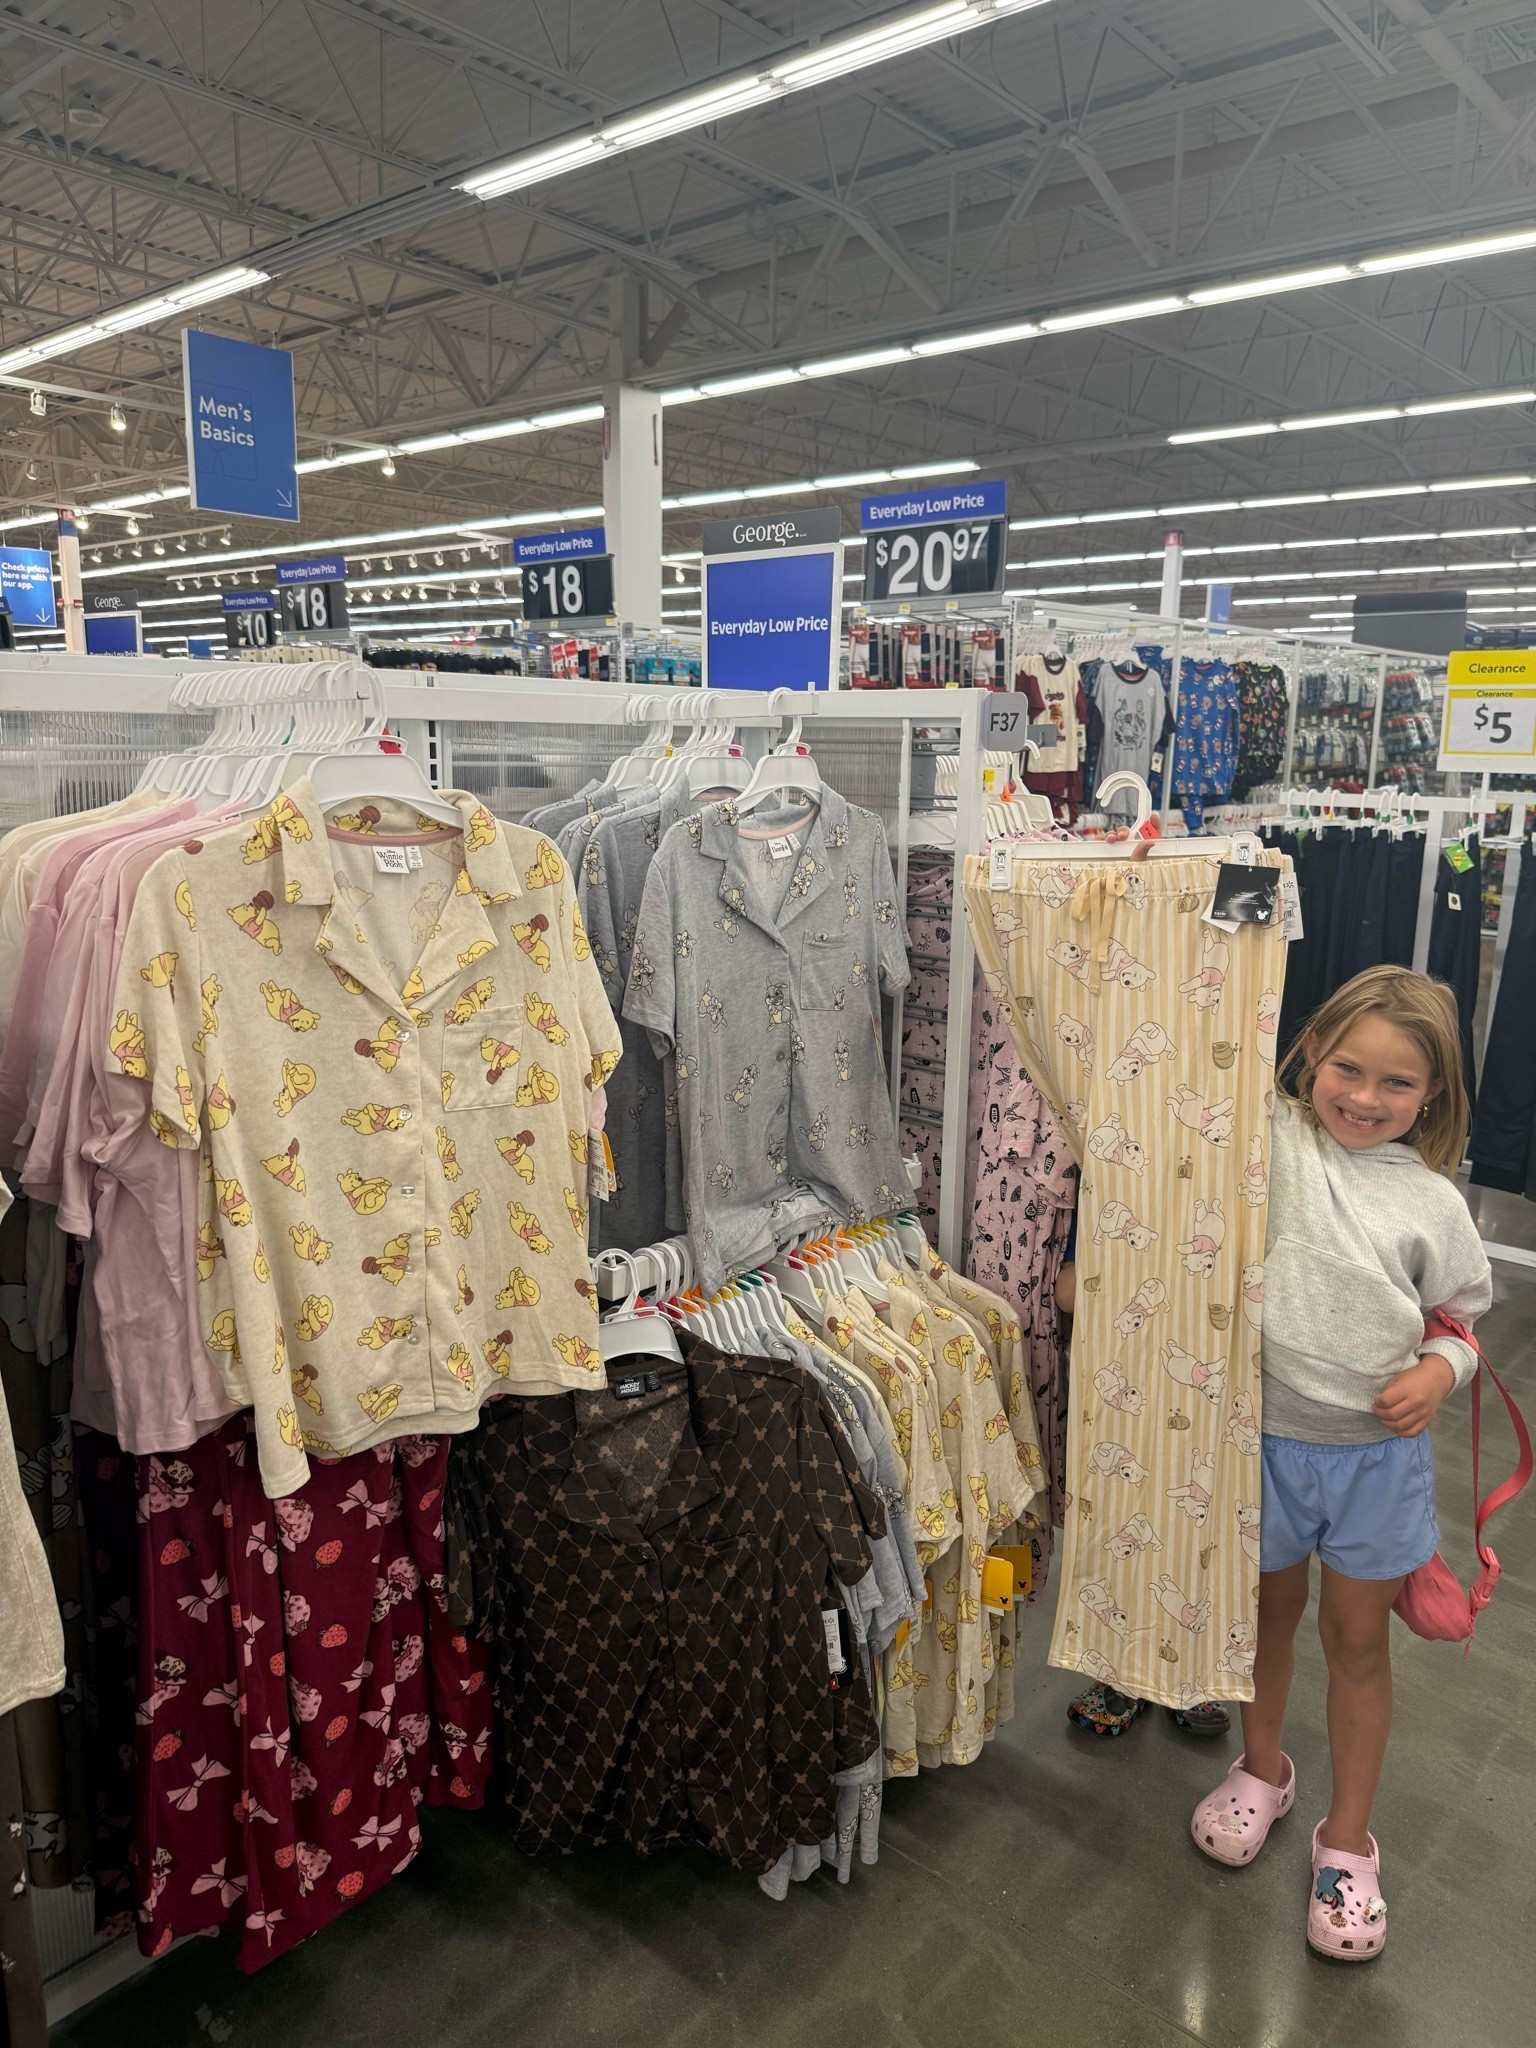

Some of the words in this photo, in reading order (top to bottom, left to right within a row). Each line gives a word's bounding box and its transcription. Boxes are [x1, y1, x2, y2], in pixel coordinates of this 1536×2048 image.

[199, 395, 252, 422] Men's
[200, 420, 255, 447] Basics
[870, 502, 925, 520] Everyday
[926, 499, 951, 514] Low
[953, 494, 985, 510] Price
[519, 543, 555, 556] Everyday
[555, 540, 572, 552] Low
[572, 537, 593, 549] Price
[1, 562, 26, 571] Check
[26, 565, 49, 574] prices
[281, 568, 309, 579] Everyday
[309, 566, 320, 576] Low
[320, 564, 337, 575] Price
[2, 571, 19, 580] here
[30, 573, 48, 582] with
[18, 582, 34, 590] app.
[225, 598, 246, 607] Everyday
[246, 597, 255, 605] Low
[255, 596, 268, 605] Price
[711, 619, 767, 637] Everyday
[769, 618, 794, 633] Low
[796, 616, 829, 632] Price
[1468, 663, 1527, 674] Clearance
[1476, 690, 1514, 698] Clearance
[990, 712, 1020, 732] F37
[1474, 703, 1512, 744] $5
[376, 851, 404, 860] Winnie
